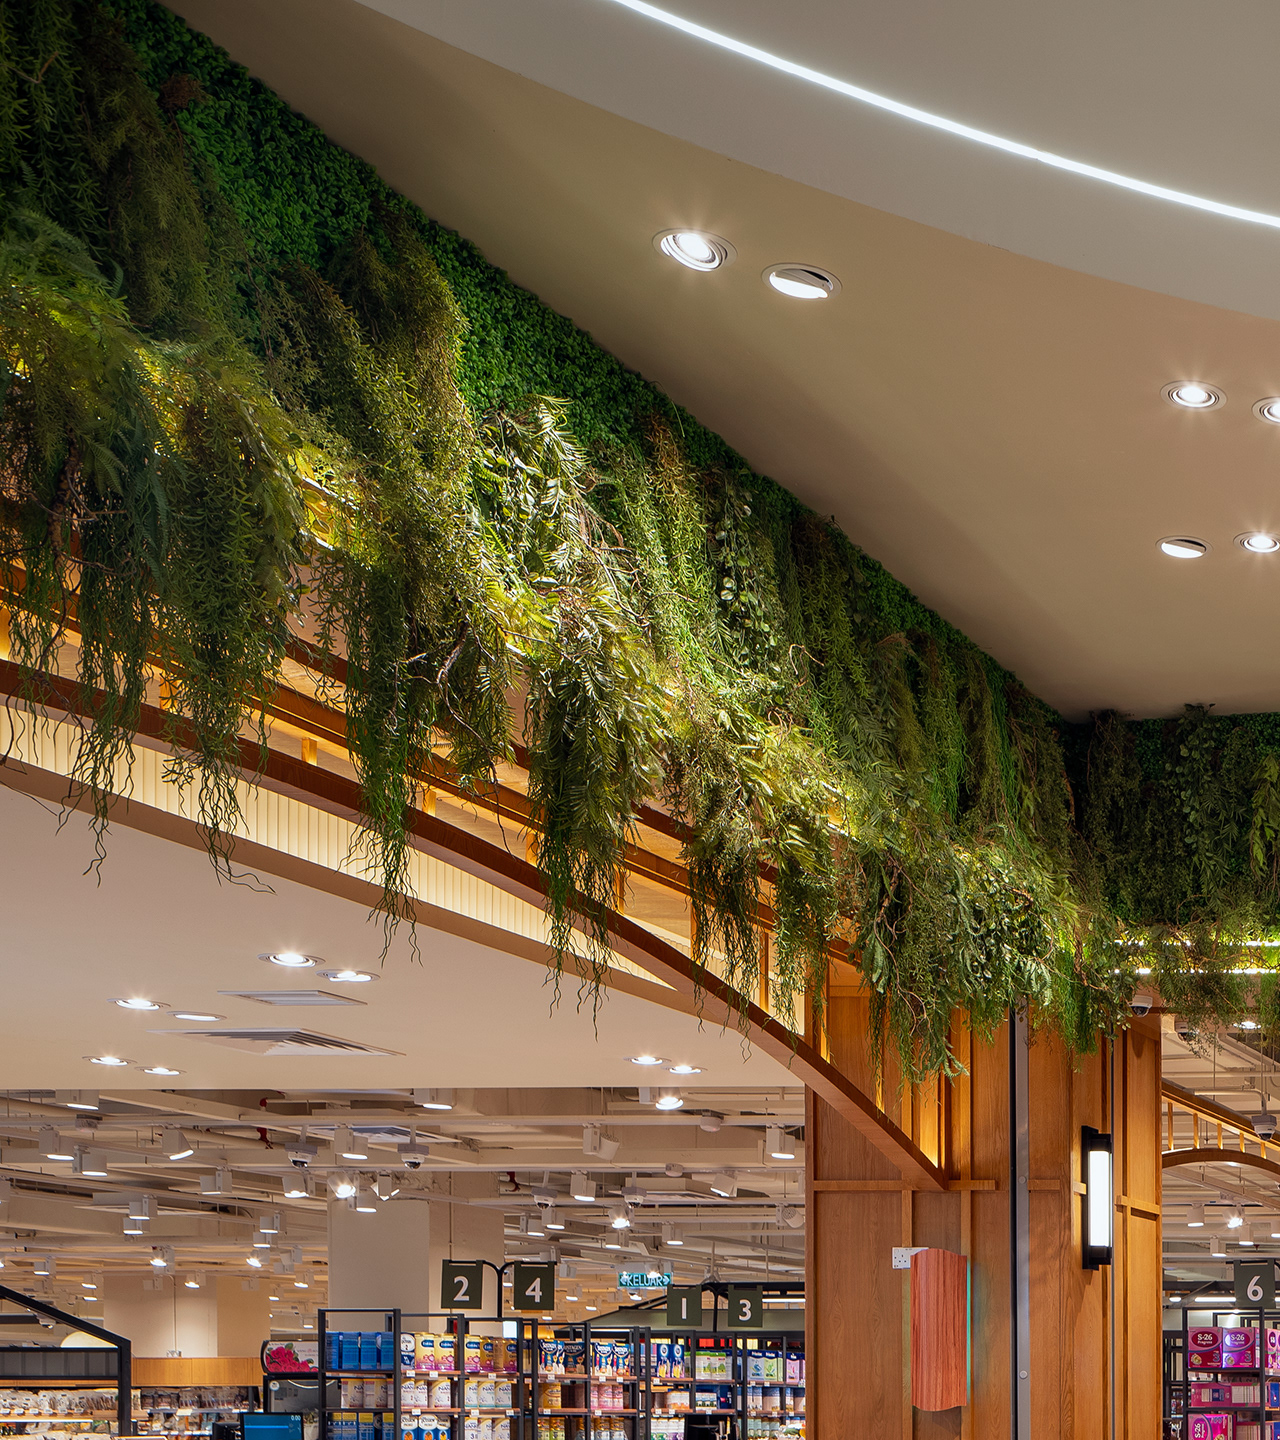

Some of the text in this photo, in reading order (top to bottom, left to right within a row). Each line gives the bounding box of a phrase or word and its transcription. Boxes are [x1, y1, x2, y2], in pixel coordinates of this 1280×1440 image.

[453, 1276, 470, 1302] 2
[525, 1277, 543, 1303] 4
[627, 1273, 664, 1287] KELUAR
[1247, 1275, 1264, 1301] 6
[681, 1297, 687, 1320] 1
[738, 1299, 752, 1322] 3
[1197, 1333, 1213, 1341] S-26
[1230, 1333, 1245, 1341] S-26
